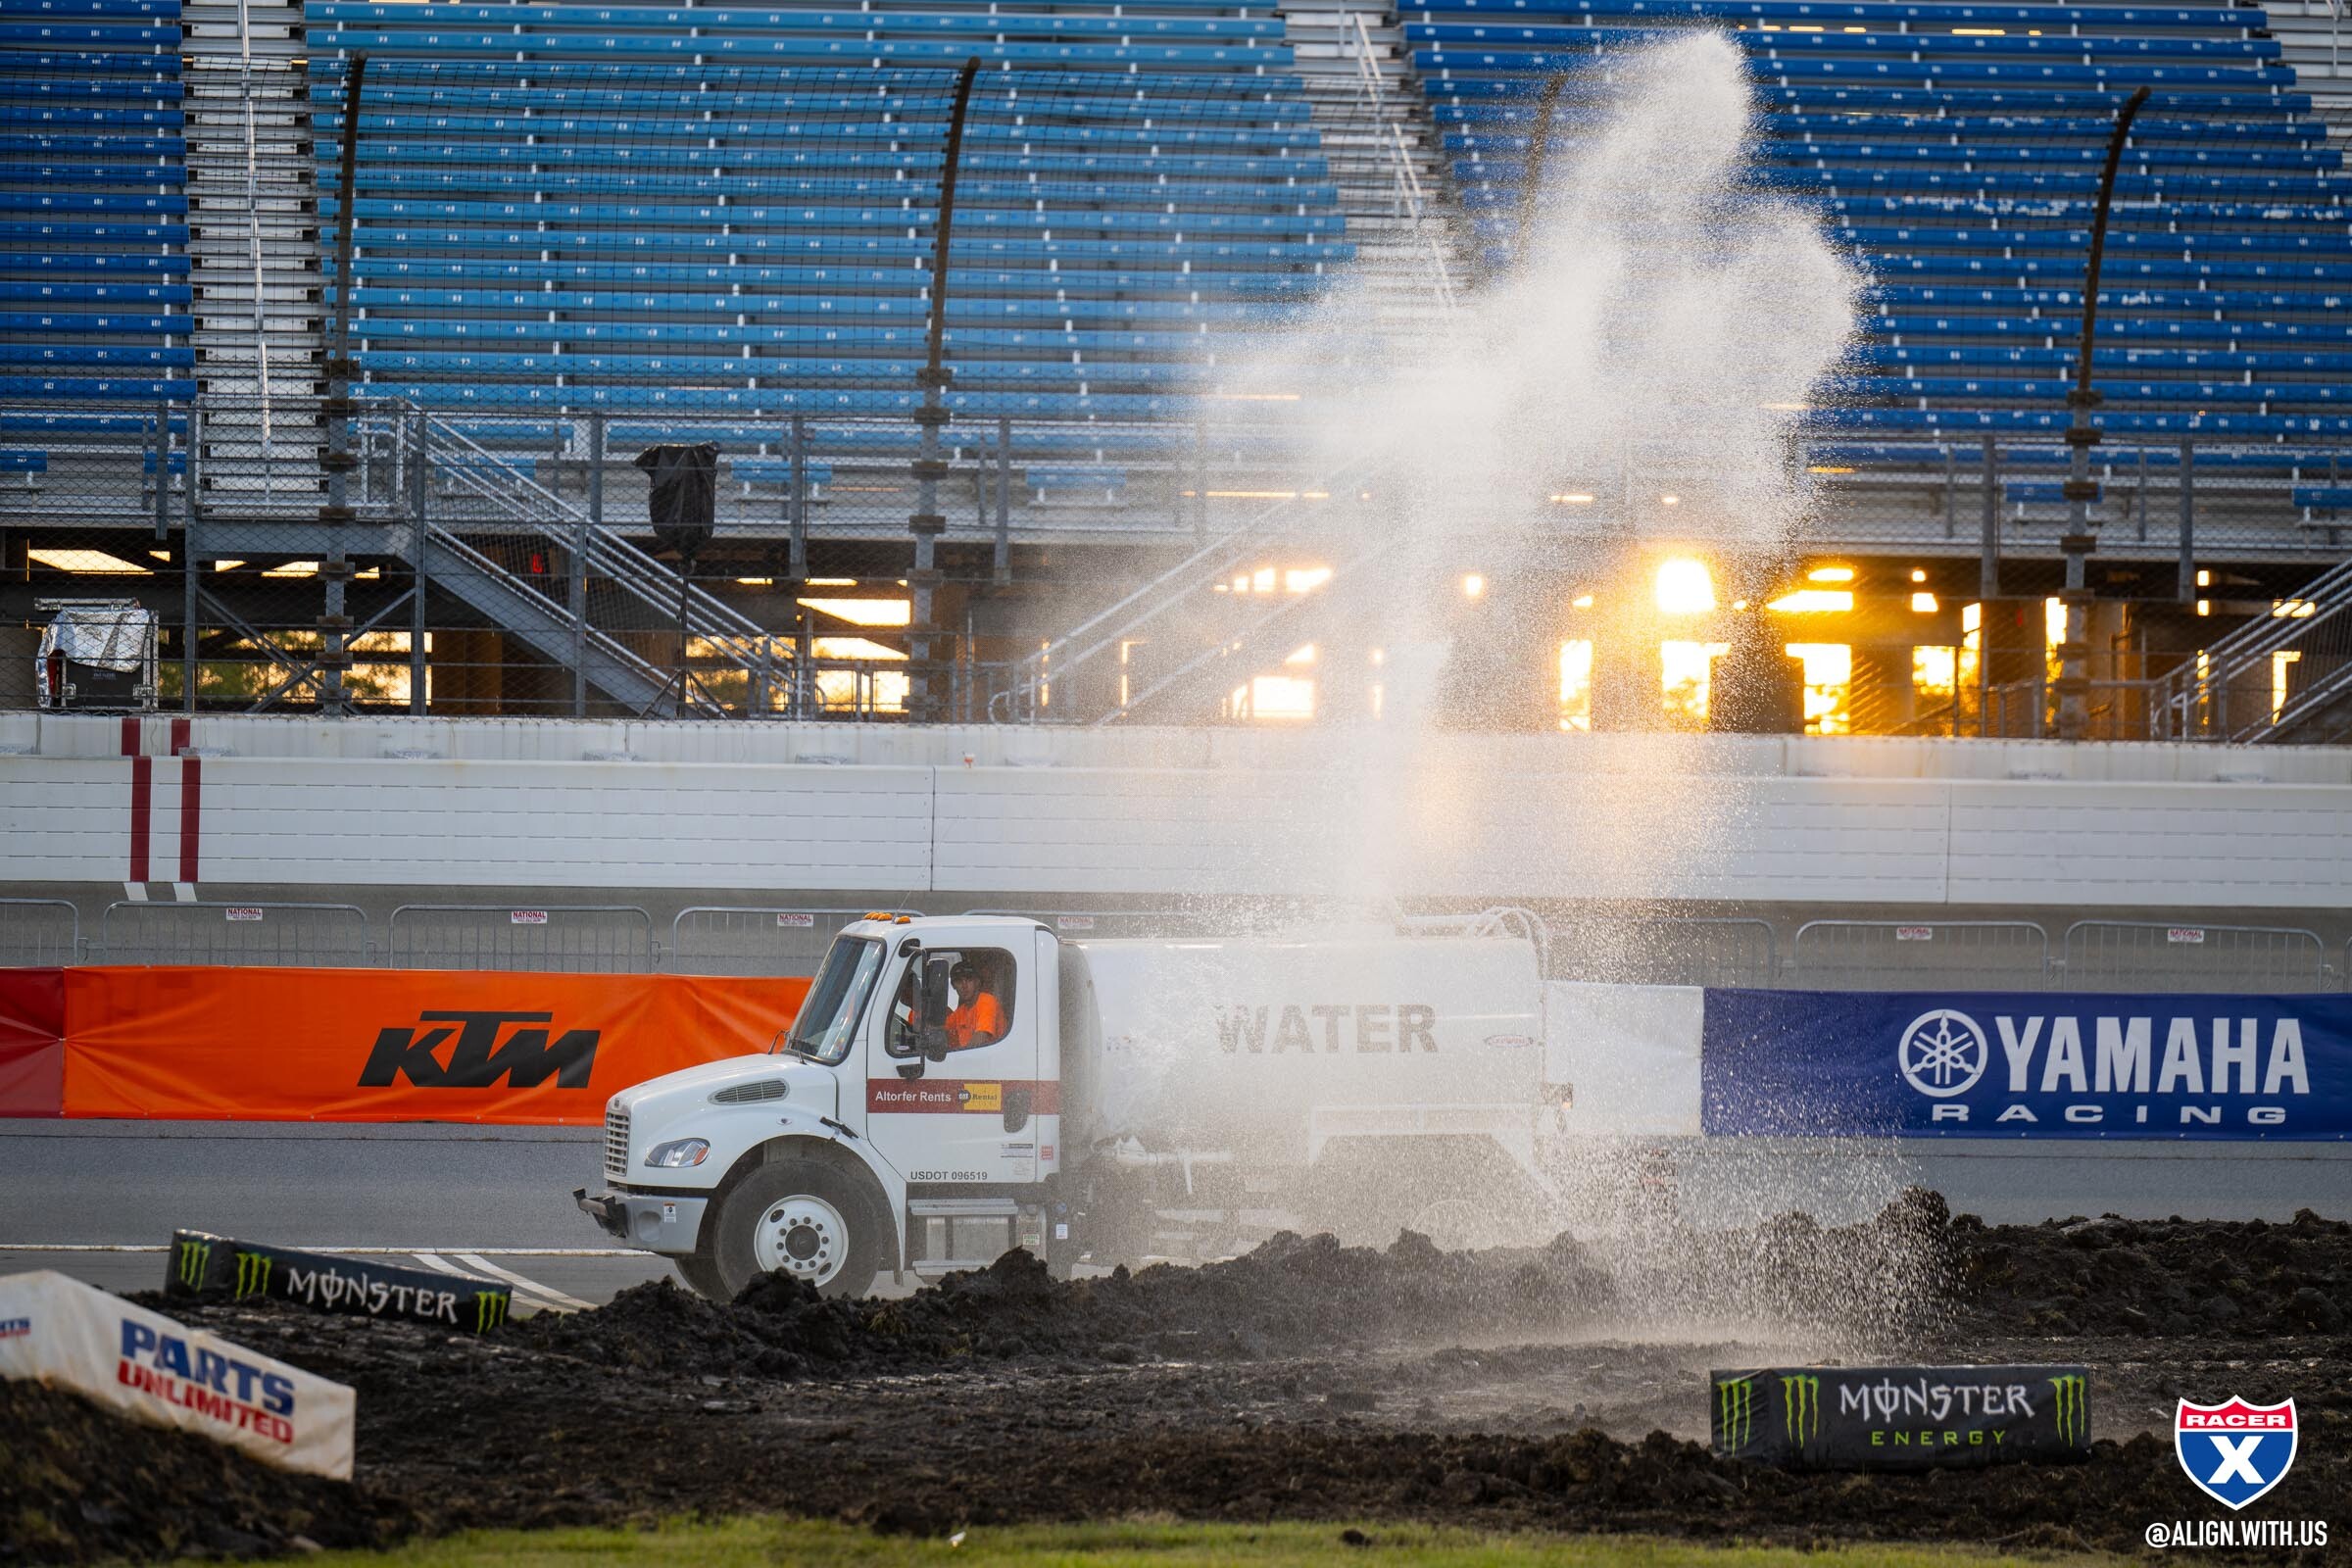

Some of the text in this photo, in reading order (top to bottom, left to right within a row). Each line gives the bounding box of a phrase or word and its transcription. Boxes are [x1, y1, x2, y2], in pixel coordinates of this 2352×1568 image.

[2170, 928, 2202, 937] NATIONAL
[357, 1010, 601, 1089] KTM
[1214, 1004, 1438, 1054] WATER
[1995, 1015, 2310, 1095] YAMAHA
[875, 1090, 953, 1102] Altorfer Rents
[1932, 1103, 2287, 1125] RACING
[910, 1170, 988, 1181] USDOT 096519
[286, 1267, 458, 1324] MONSTER
[122, 1318, 294, 1417] PARTS
[118, 1359, 294, 1445] UNLIMITED
[1838, 1377, 2035, 1423] MONSTER
[1872, 1430, 2007, 1446] ENERGY
